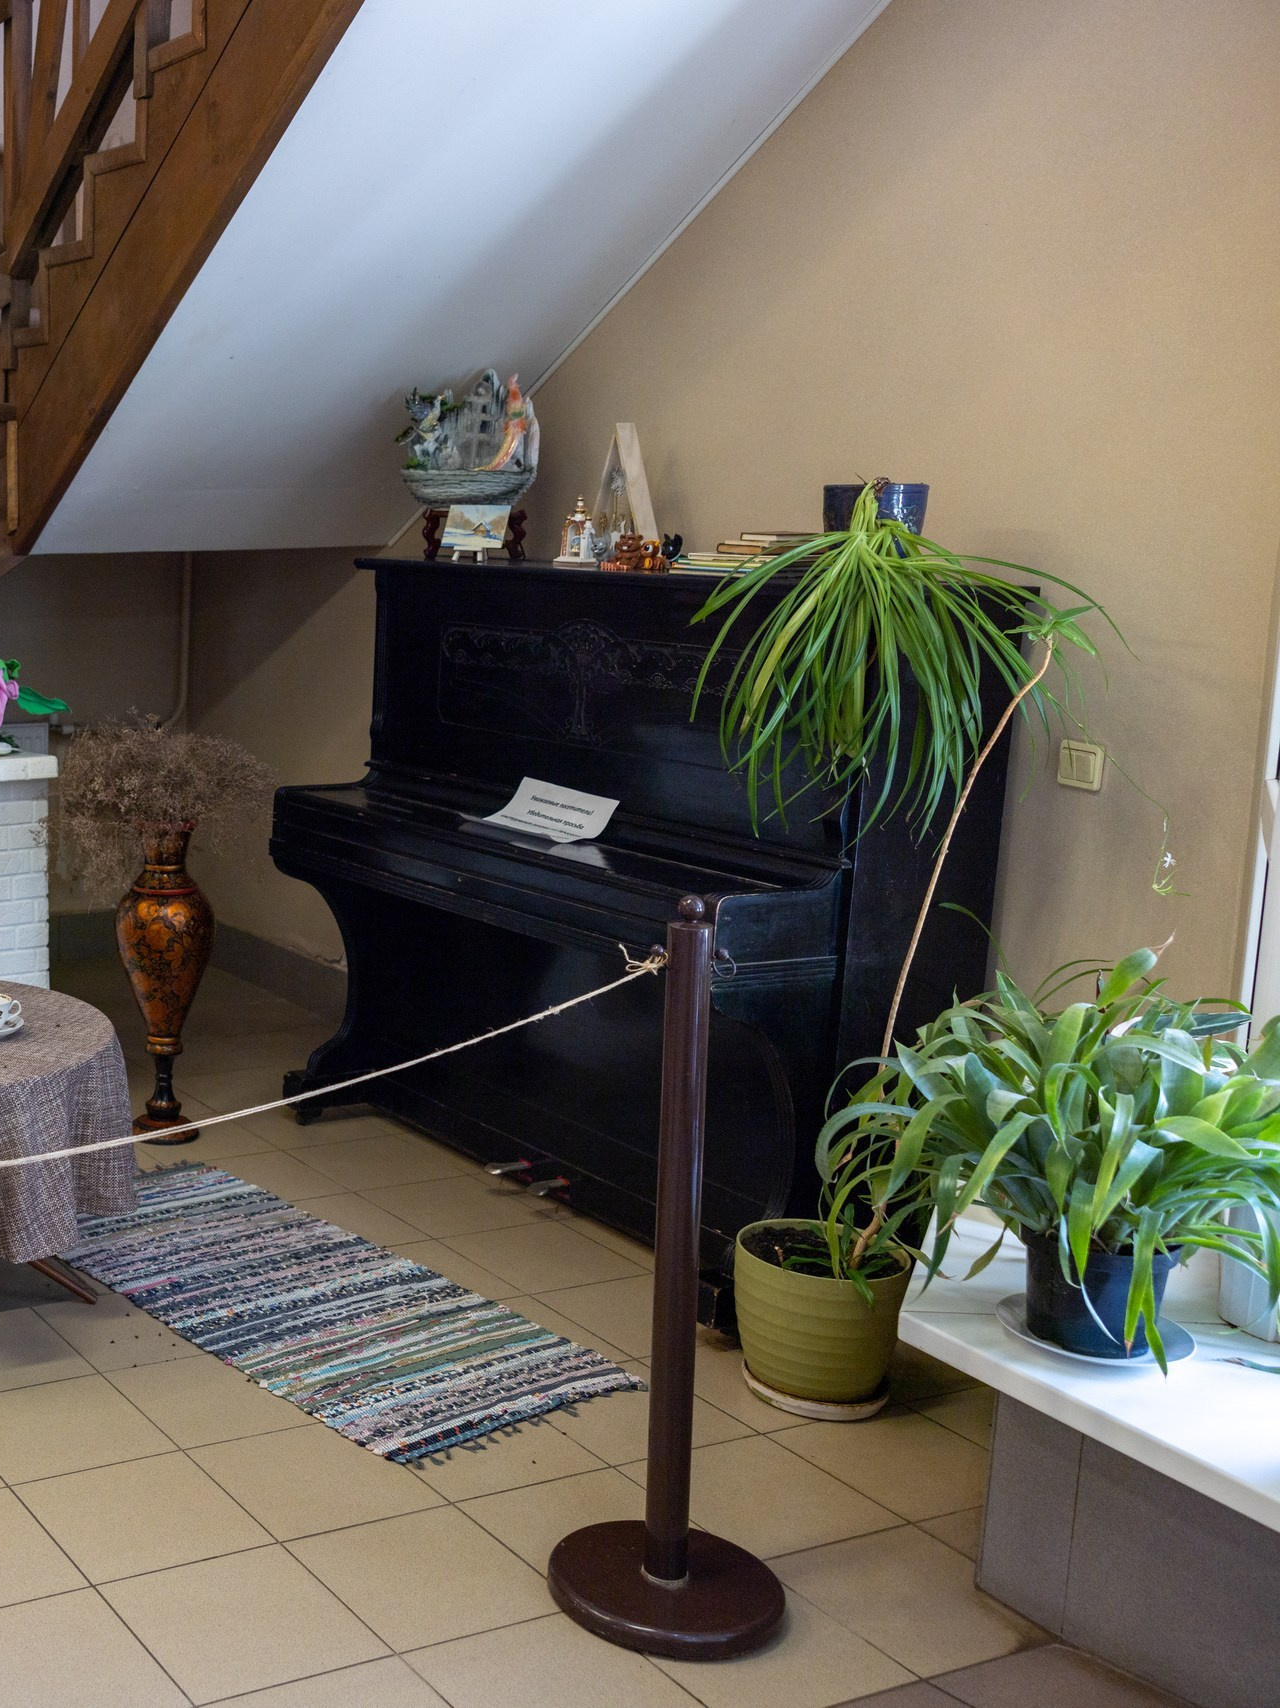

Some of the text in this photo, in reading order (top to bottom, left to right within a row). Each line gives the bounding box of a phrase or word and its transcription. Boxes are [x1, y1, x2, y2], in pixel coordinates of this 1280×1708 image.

[531, 795, 594, 816] Уважаемые посетители!
[527, 809, 563, 823] Убедительная
[563, 820, 584, 830] просьба
